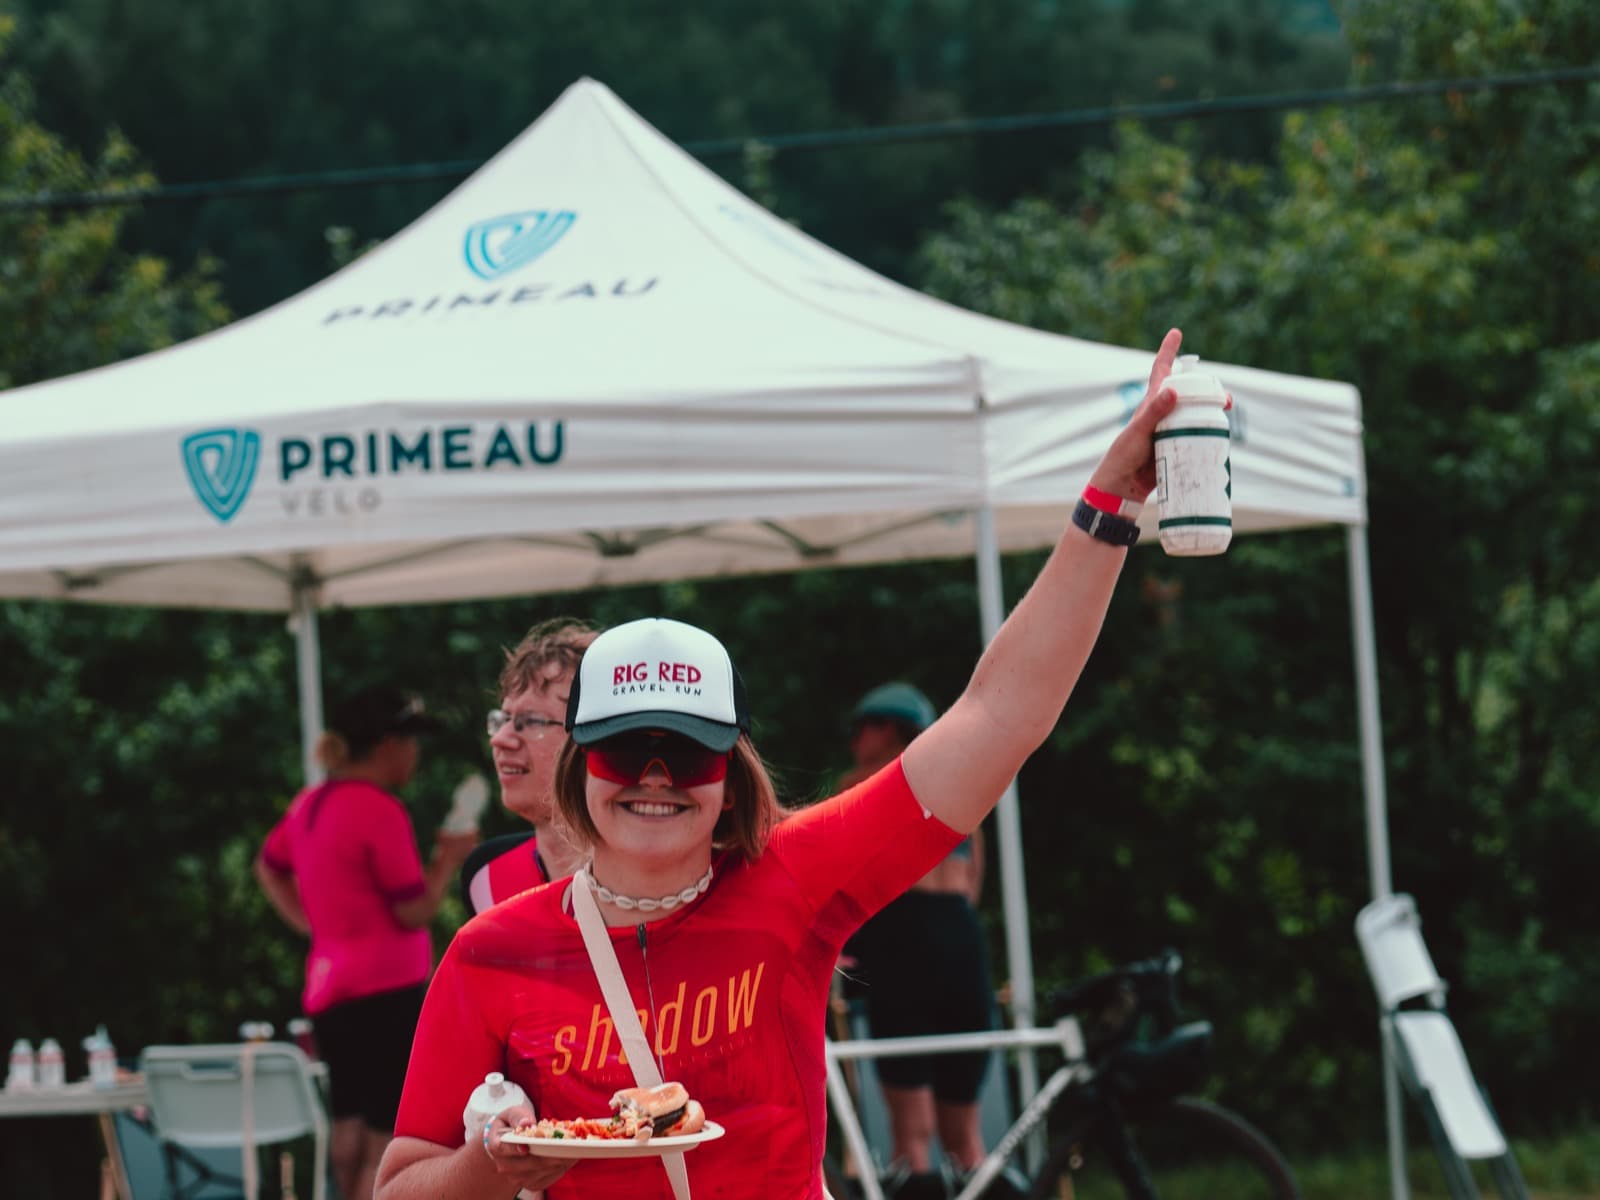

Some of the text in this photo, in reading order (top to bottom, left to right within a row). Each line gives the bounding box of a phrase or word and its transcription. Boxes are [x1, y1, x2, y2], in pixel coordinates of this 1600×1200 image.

[322, 277, 659, 326] PRIMEAU
[278, 419, 566, 483] PRIMEAU
[612, 683, 702, 697] GRAVEL RUN
[613, 661, 702, 686] BIG RED
